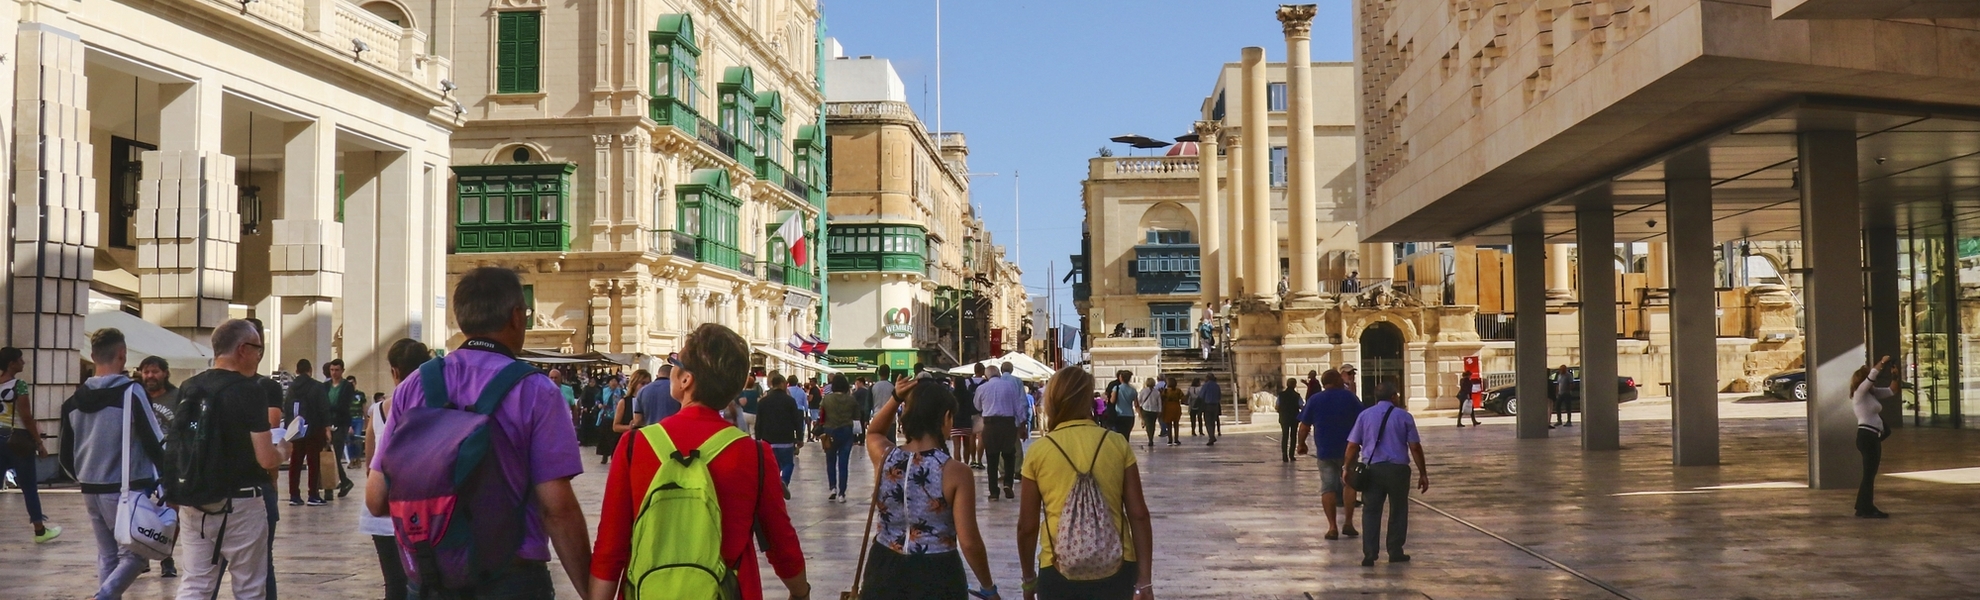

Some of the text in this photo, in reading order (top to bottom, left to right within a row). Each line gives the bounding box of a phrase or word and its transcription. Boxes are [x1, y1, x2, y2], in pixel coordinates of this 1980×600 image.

[884, 324, 914, 334] WEMBLEY
[467, 340, 495, 349] Canon
[137, 526, 168, 545] adidas
